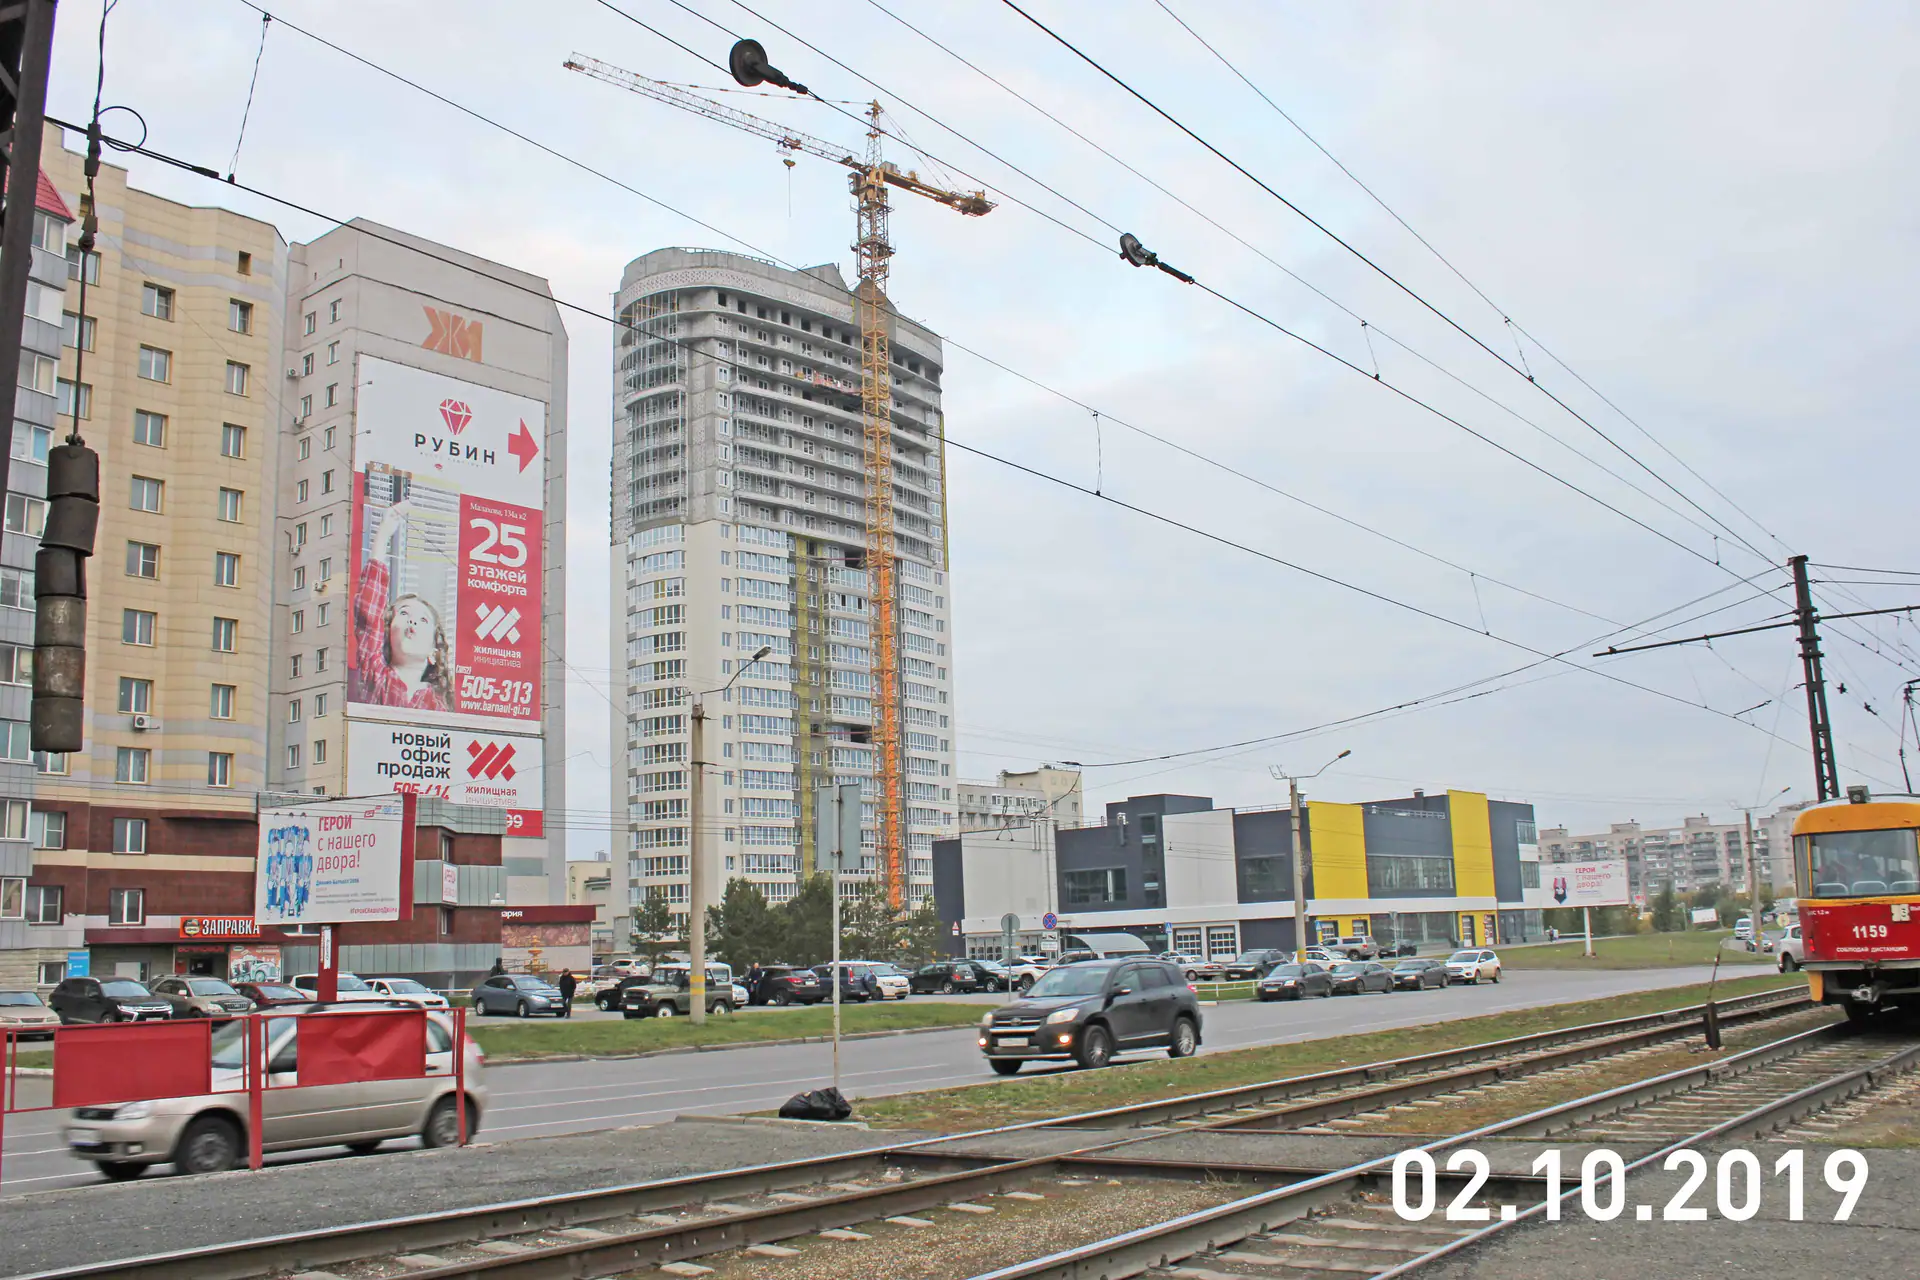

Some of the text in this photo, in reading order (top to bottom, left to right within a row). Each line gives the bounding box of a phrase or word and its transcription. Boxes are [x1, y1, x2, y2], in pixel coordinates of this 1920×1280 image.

[414, 433, 495, 465] РУБИН
[469, 502, 503, 517] Малахова,
[469, 518, 528, 568] 25
[468, 563, 527, 584] этажей
[467, 578, 527, 596] комфорта
[473, 645, 522, 659] жилищная
[473, 655, 522, 668] инициатива
[460, 674, 533, 704] 505-313
[460, 700, 531, 716] www.barnaul-gi.ru
[392, 732, 450, 749] новый
[401, 747, 450, 764] офис
[377, 762, 450, 779] продаж
[465, 785, 517, 797] жилищная
[317, 833, 376, 851] с нашего
[316, 850, 360, 874] двора!
[202, 919, 260, 935] ЗАПРАВКА
[1852, 925, 1888, 938] 1159
